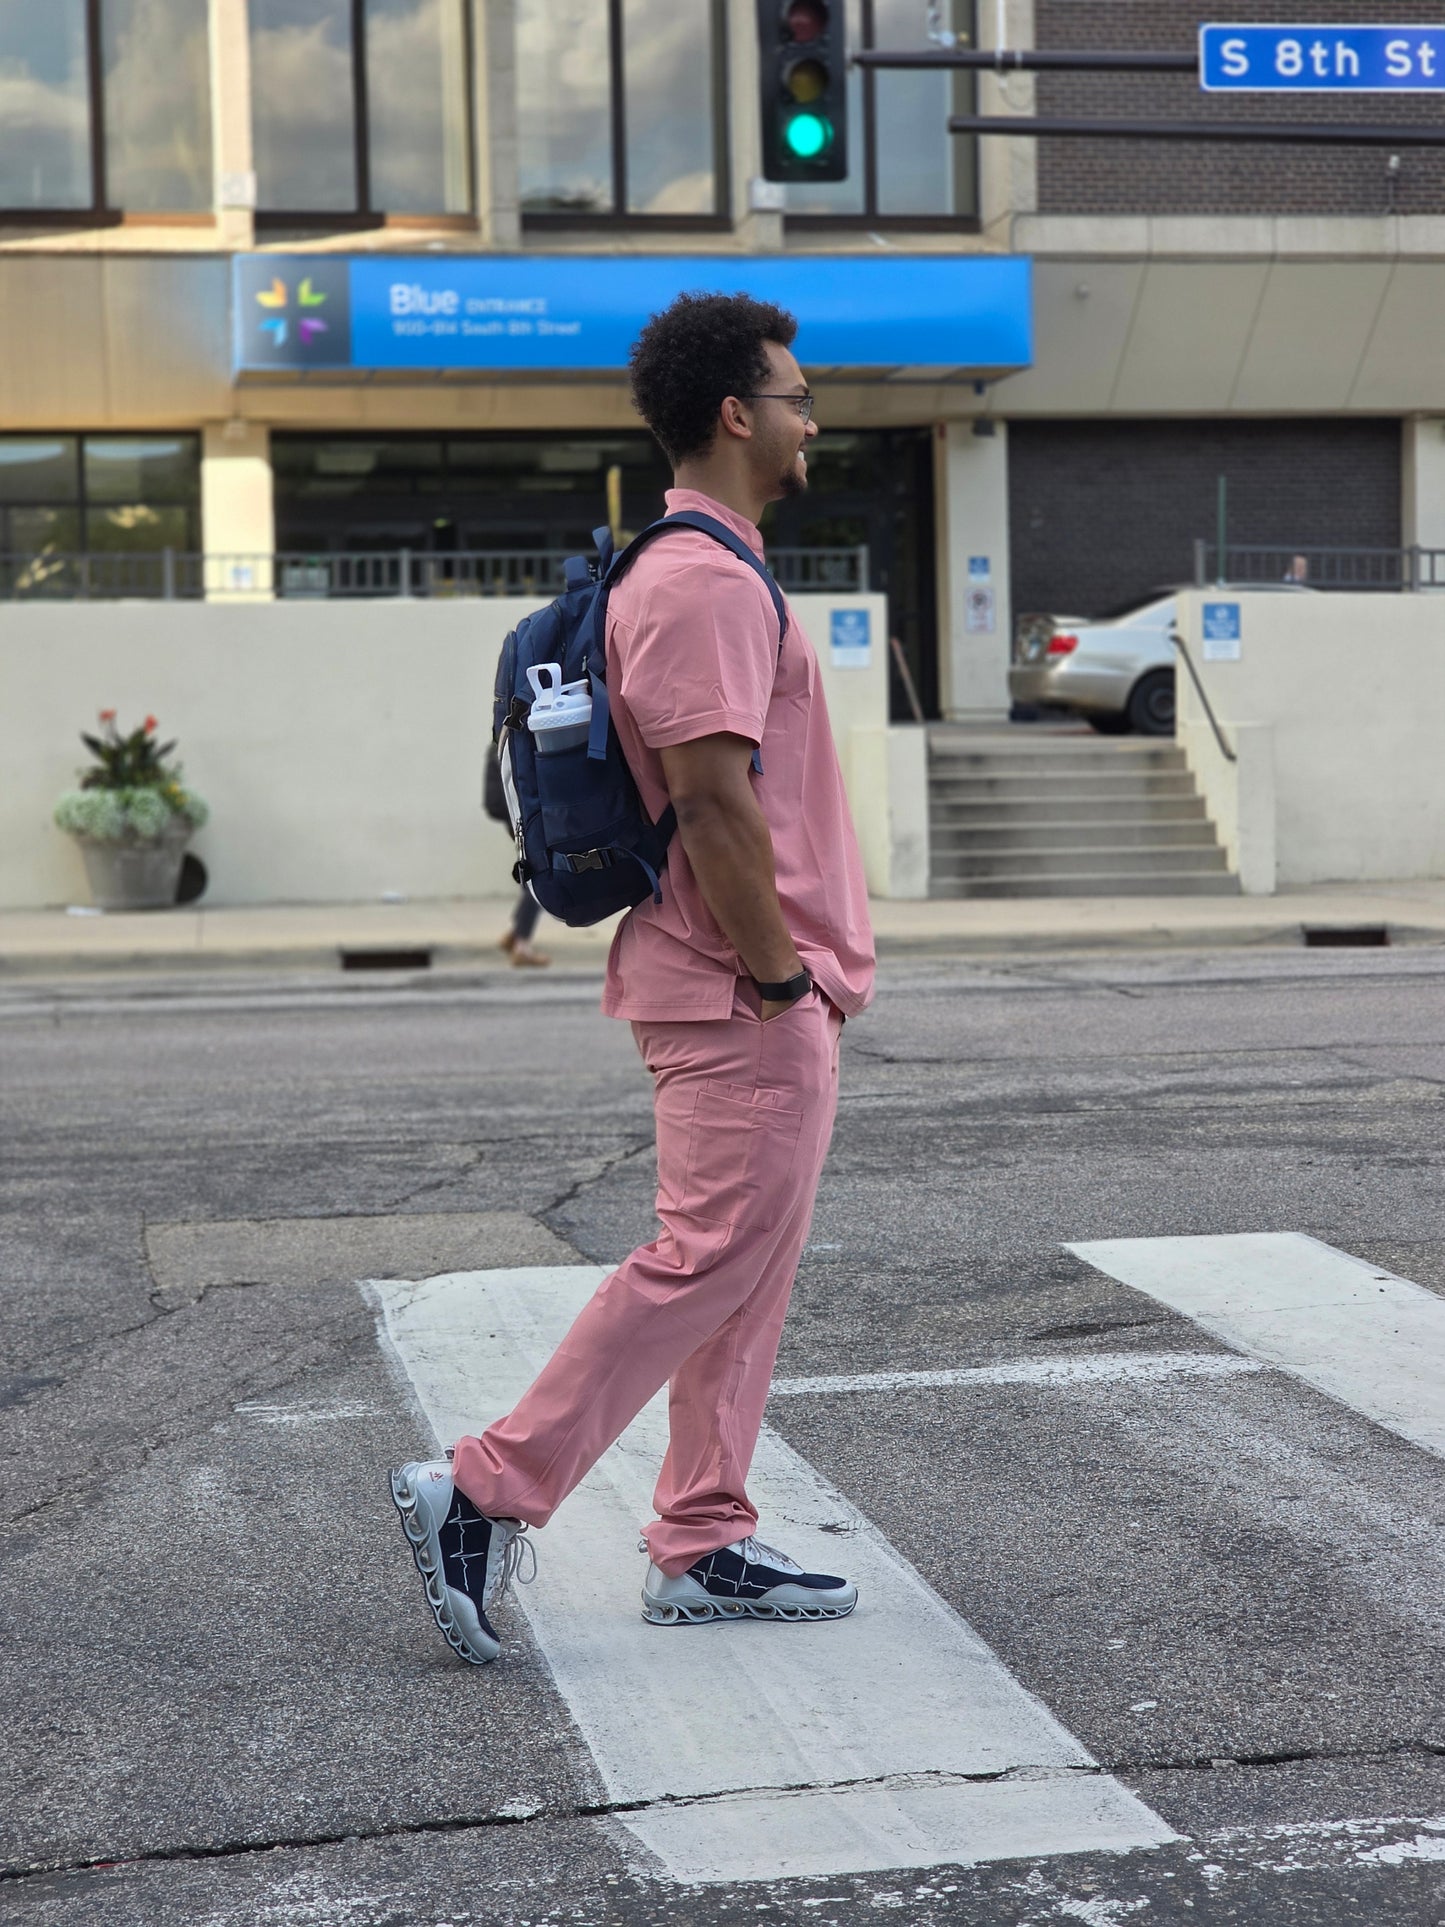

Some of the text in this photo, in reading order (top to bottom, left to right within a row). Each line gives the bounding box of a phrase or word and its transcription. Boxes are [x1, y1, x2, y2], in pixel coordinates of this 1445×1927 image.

[1220, 39, 1435, 77] S 8th St
[389, 283, 460, 315] Blue
[462, 320, 503, 336] South
[538, 320, 581, 336] Street
